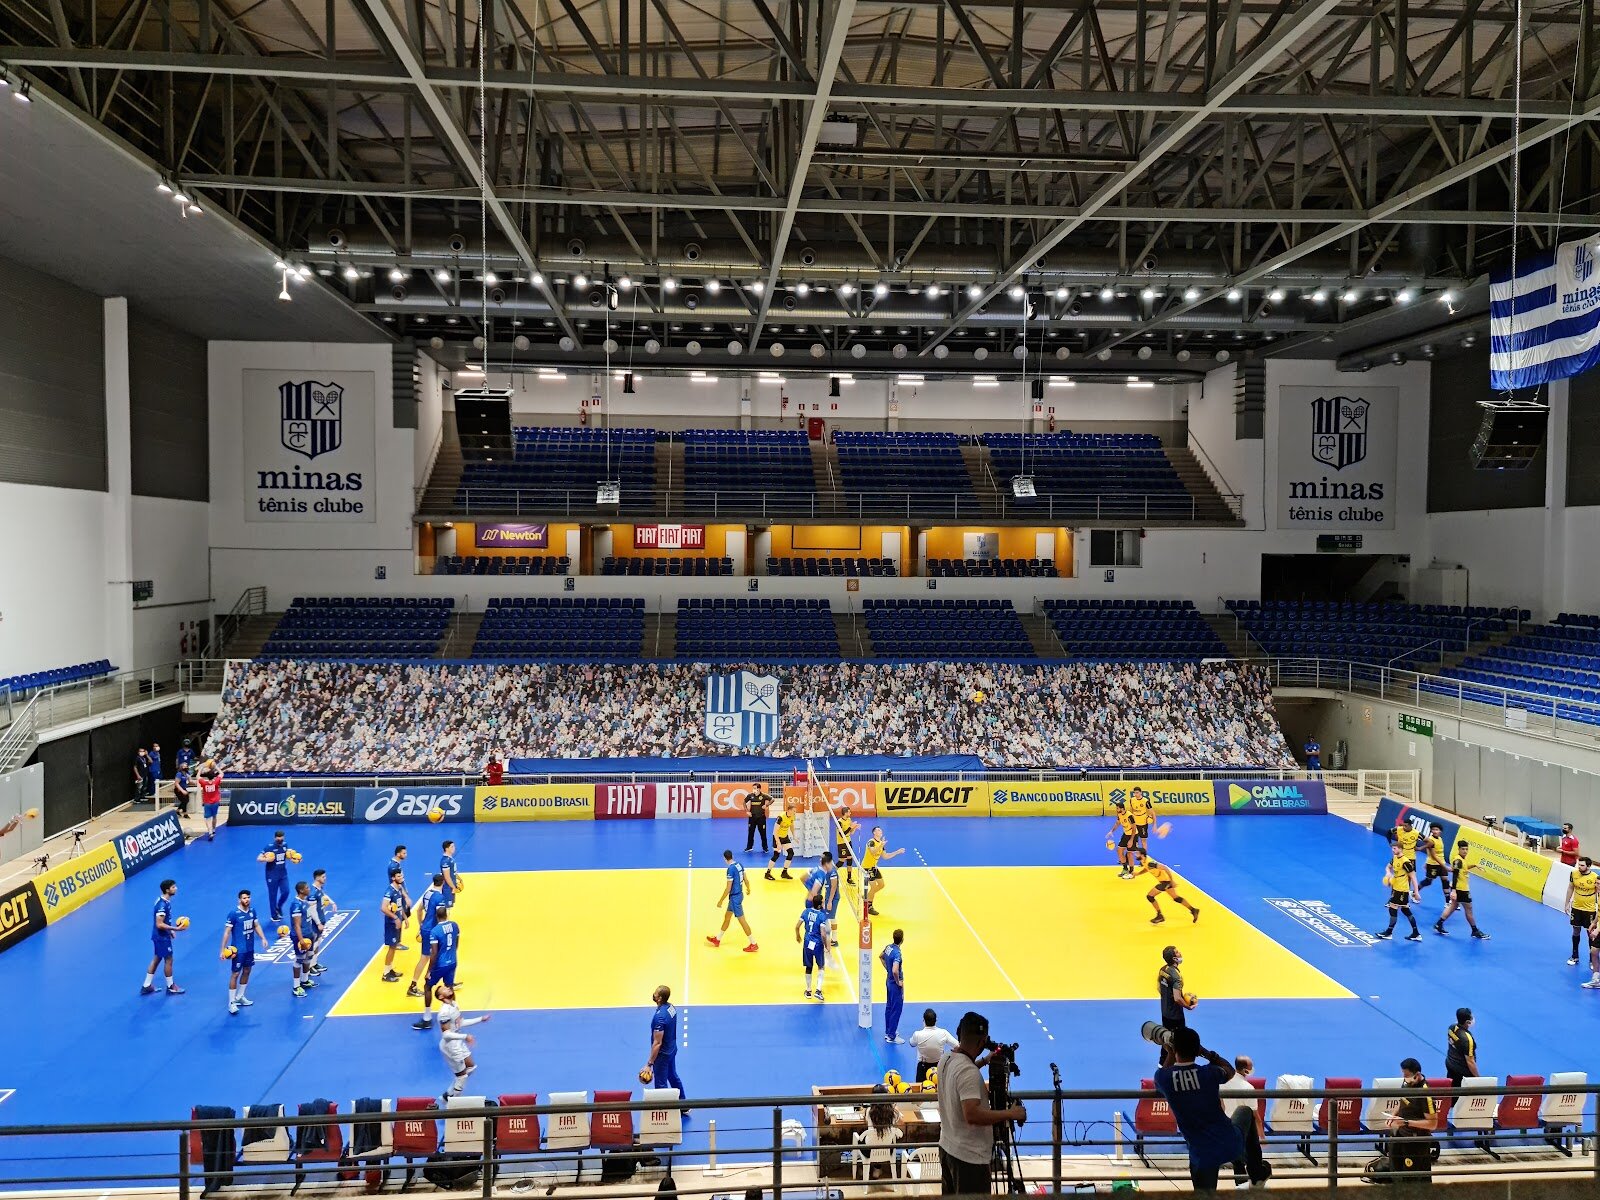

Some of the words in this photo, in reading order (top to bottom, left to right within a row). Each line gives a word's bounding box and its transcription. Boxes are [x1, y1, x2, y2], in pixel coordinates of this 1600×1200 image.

[257, 465, 362, 491] minas
[1288, 476, 1384, 500] minas
[258, 497, 307, 513] tênis
[313, 497, 363, 513] clube
[1288, 506, 1333, 521] tênis
[1338, 507, 1384, 522] clube
[500, 530, 542, 541] Newton
[636, 527, 658, 544] FIAT
[659, 528, 680, 544] FIAT
[682, 528, 702, 544] FIAT
[884, 786, 974, 804] VEDACIT
[1011, 792, 1048, 803] BANCO
[1050, 792, 1064, 802] DO
[1065, 790, 1102, 802] BRASIL
[1153, 791, 1210, 804] SEGUROS
[1252, 785, 1303, 798] CANAL
[500, 797, 538, 808] BANCO
[539, 798, 552, 807] DO
[555, 796, 590, 807] BRASIL
[607, 785, 646, 814] FIAT
[668, 785, 704, 814] FIAT
[713, 788, 748, 811] GO
[1255, 798, 1280, 807] VÔLEI
[1282, 799, 1311, 807] BRASIL
[237, 801, 278, 815] VÔLEI
[297, 802, 345, 815] BRASIL
[136, 819, 178, 850] RECOMA
[59, 873, 77, 897] BB
[76, 856, 118, 888] SEGUROS
[808, 921, 814, 933] 7
[1172, 1068, 1200, 1092] FIAT
[1470, 1098, 1487, 1107] FIAT
[1515, 1097, 1533, 1107] FIAT
[1560, 1094, 1577, 1104] FIAT
[559, 1115, 576, 1126] FIAT
[602, 1113, 620, 1124] FIAT
[651, 1111, 669, 1121] FIAT
[405, 1122, 423, 1132] FIAT
[456, 1120, 474, 1130] FIAT
[509, 1119, 527, 1129] FIAT
